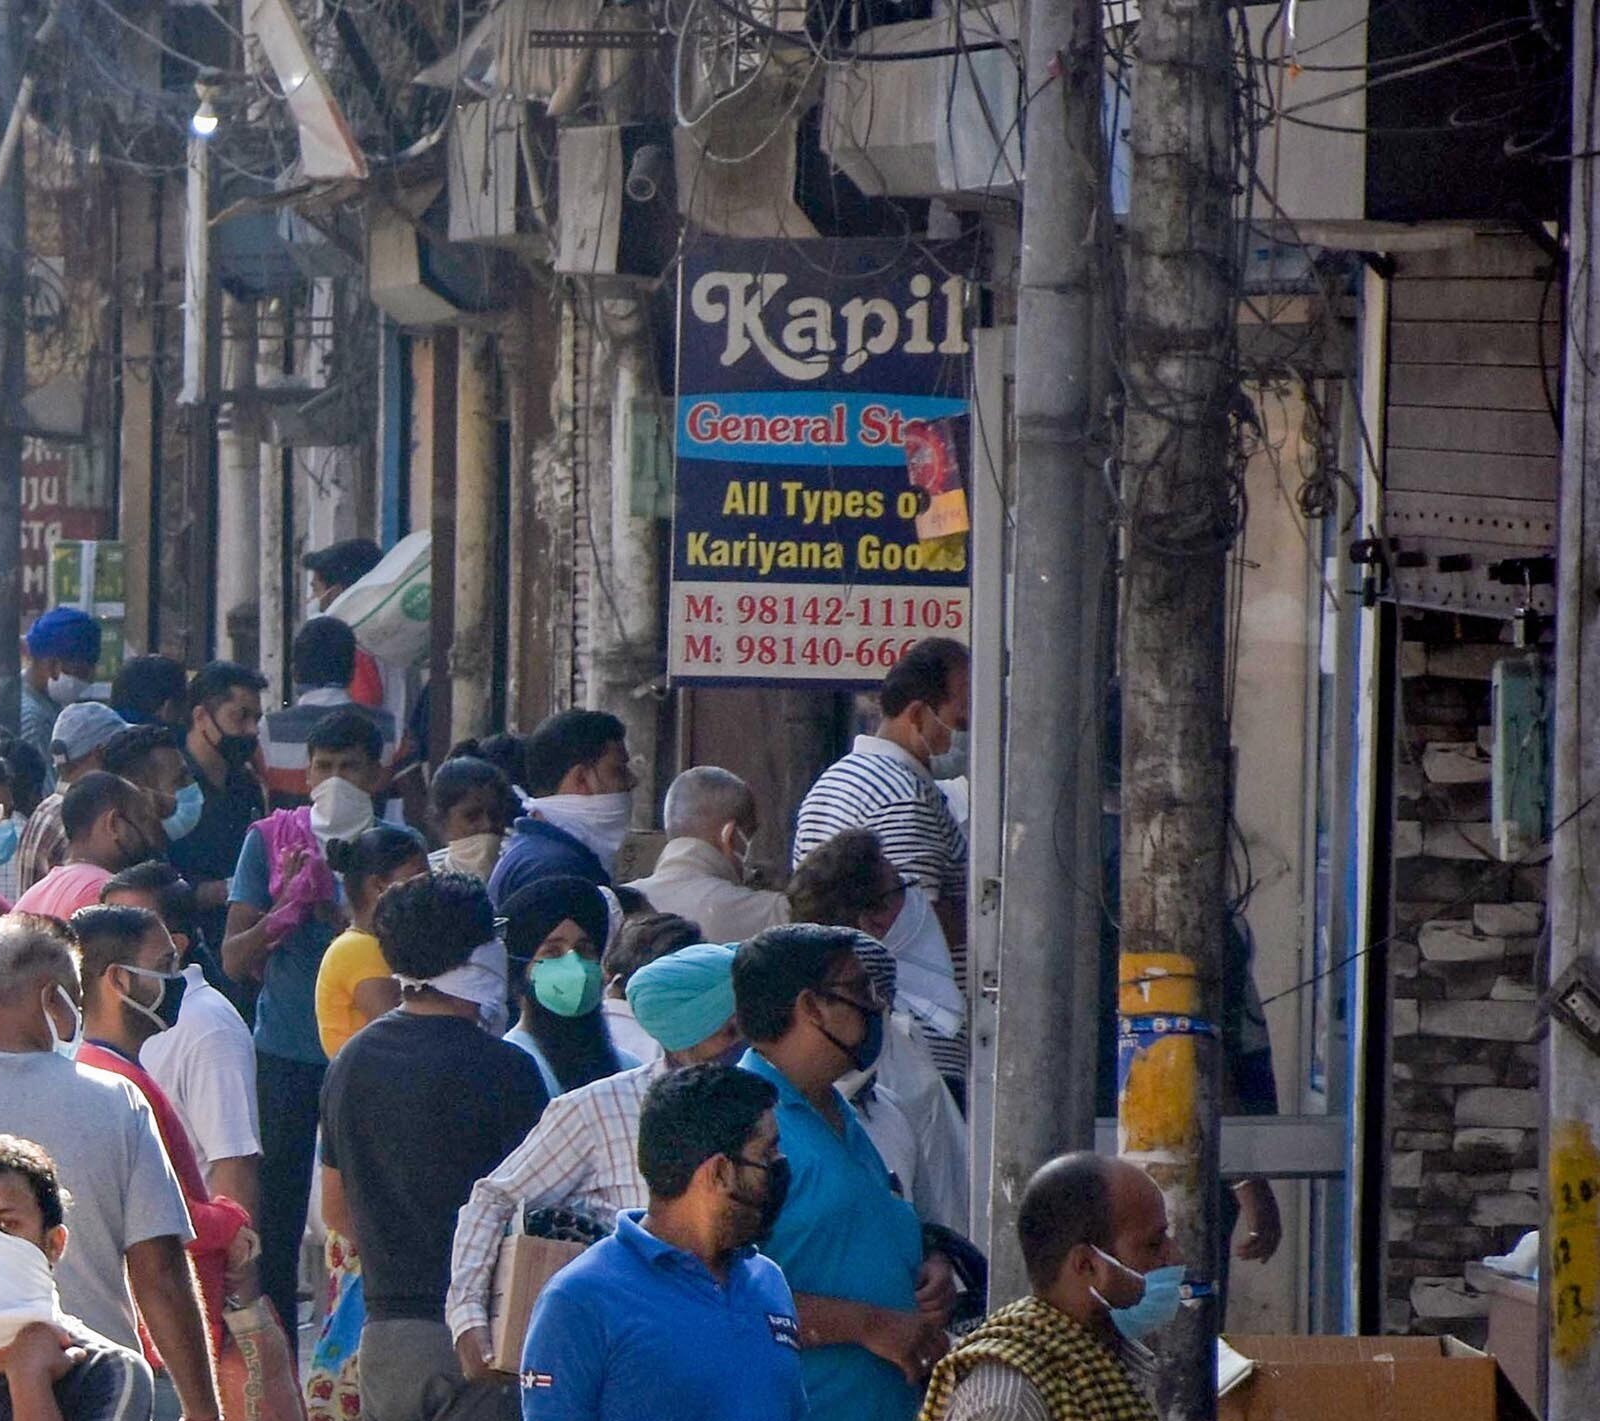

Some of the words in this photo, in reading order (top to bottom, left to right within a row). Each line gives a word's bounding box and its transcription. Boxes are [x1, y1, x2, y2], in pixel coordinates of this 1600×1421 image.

[691, 271, 970, 381] Kapil
[686, 401, 846, 447] General
[722, 481, 768, 516] All
[781, 482, 884, 526] Types
[897, 493, 920, 518] o
[686, 532, 844, 575] Kariyana
[857, 534, 966, 572] Goo
[684, 594, 723, 625] M:
[736, 595, 963, 629] 98142-11105
[683, 634, 722, 664] M:
[735, 634, 916, 667] 98140-66
